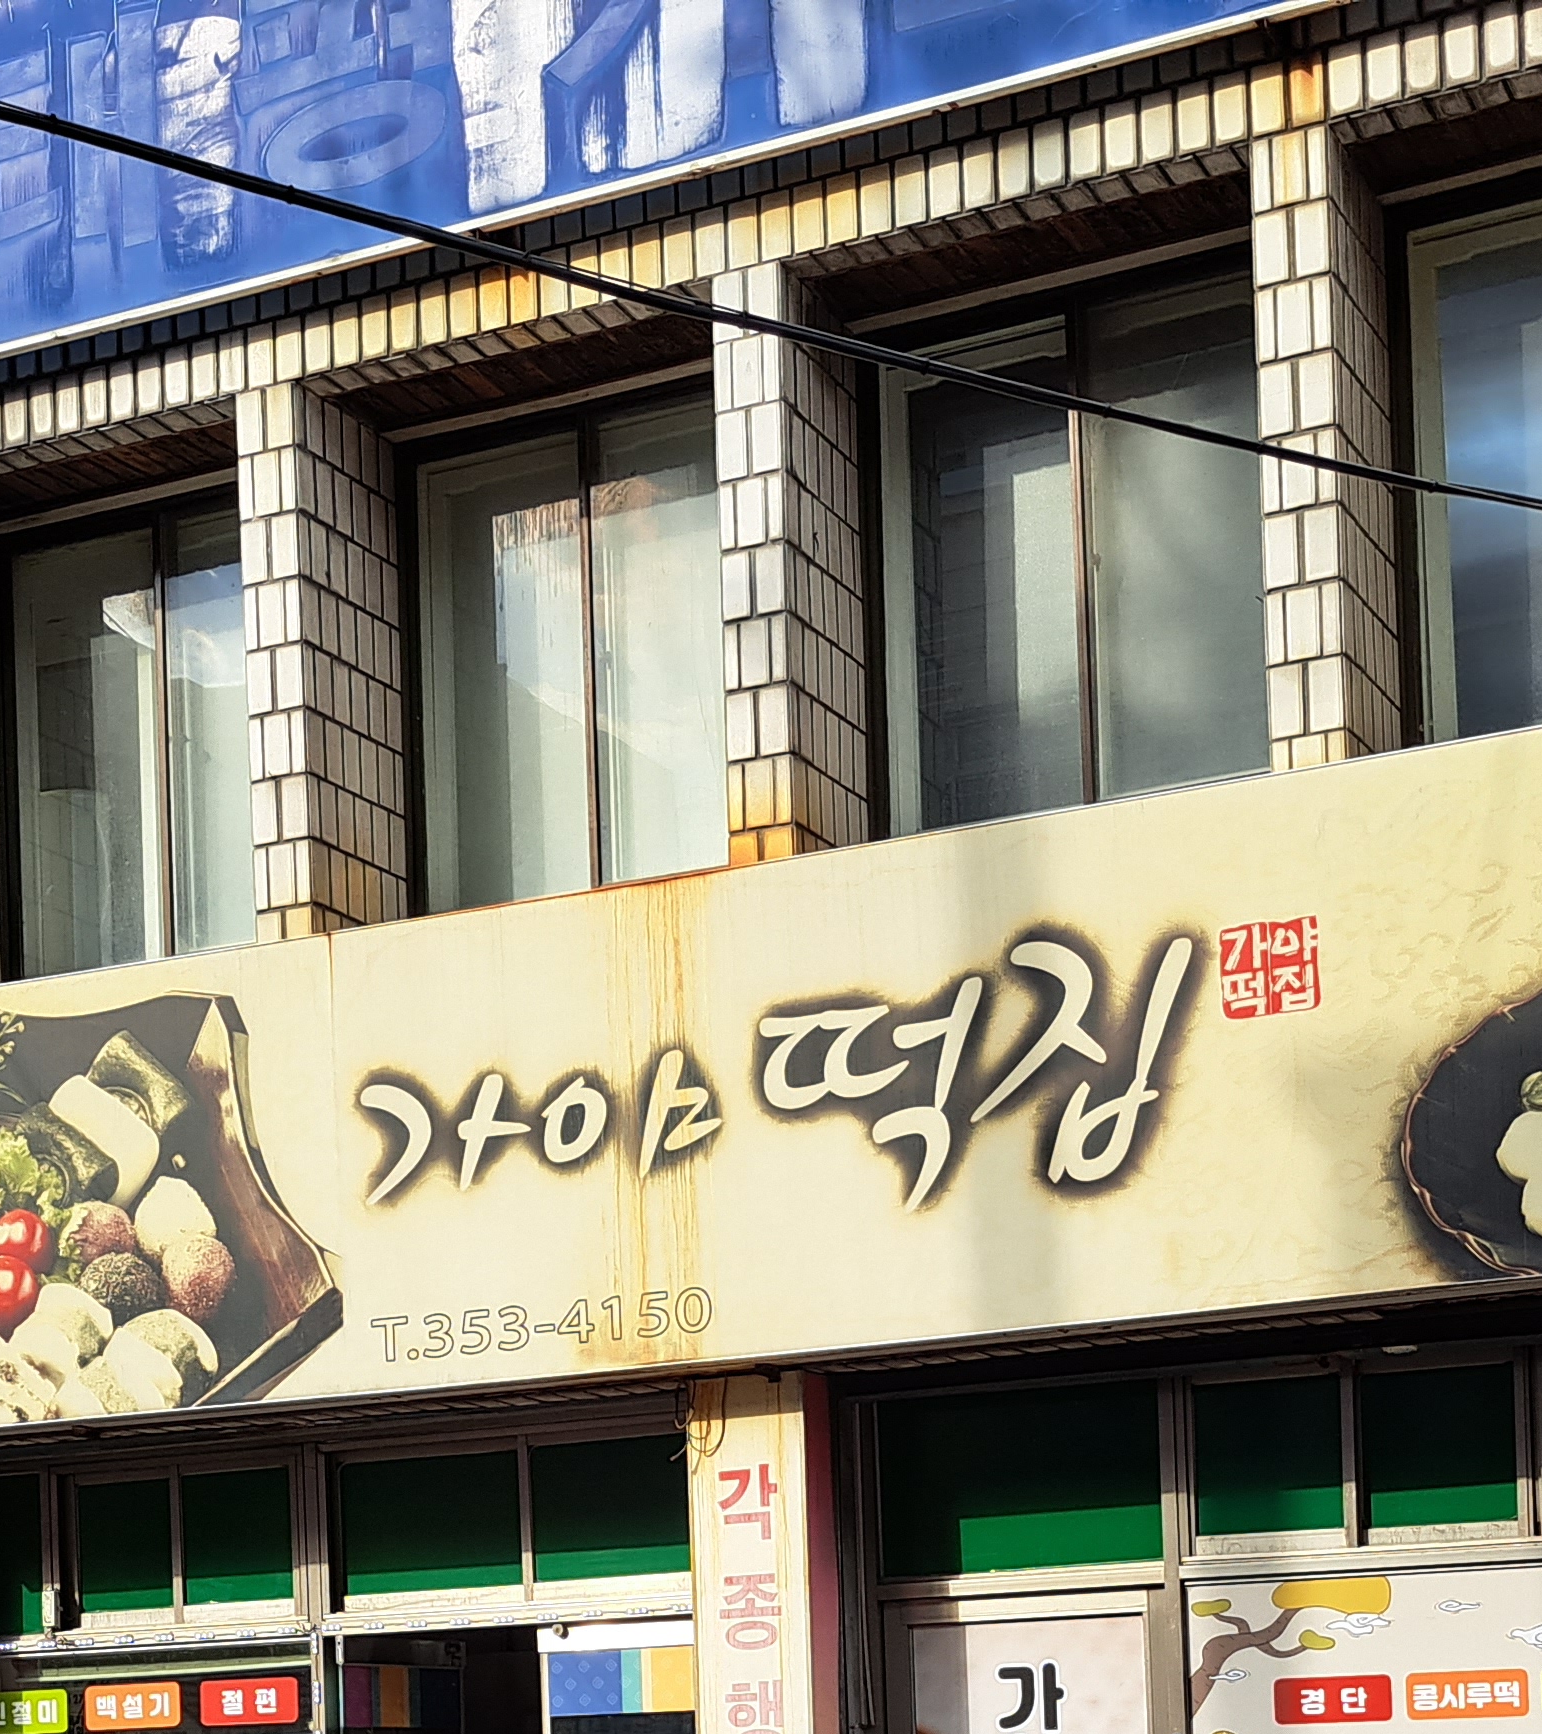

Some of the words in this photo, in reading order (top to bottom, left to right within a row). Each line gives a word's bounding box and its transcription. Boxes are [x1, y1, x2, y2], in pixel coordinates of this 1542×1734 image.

[360, 1048, 723, 1206] 가야
[759, 936, 1198, 1213] 떡집
[371, 1286, 713, 1363] T.353-4150
[95, 1692, 171, 1719] 백설기
[1411, 1681, 1522, 1711] 콩시루떡
